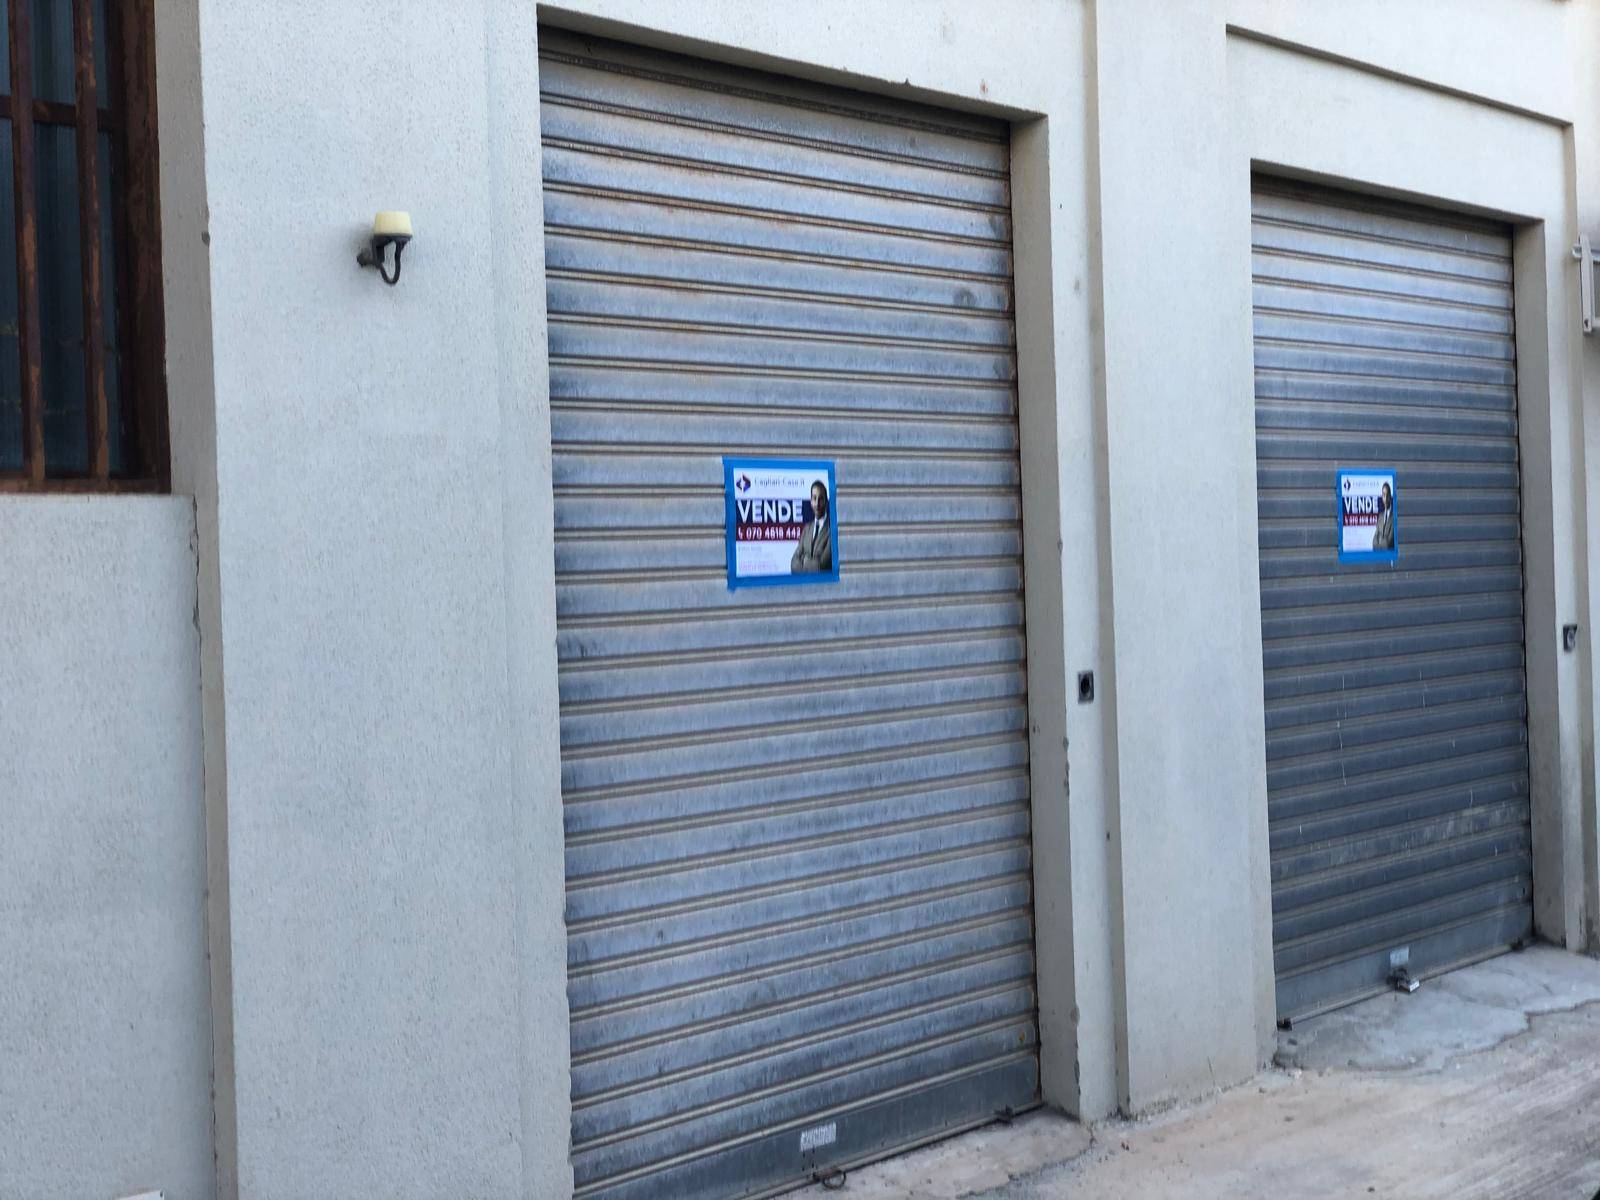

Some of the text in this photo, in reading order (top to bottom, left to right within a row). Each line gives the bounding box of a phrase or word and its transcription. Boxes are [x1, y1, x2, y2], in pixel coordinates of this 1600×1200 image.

[737, 499, 803, 523] VENDE
[1344, 496, 1379, 514] VENDE
[746, 526, 762, 540] 070
